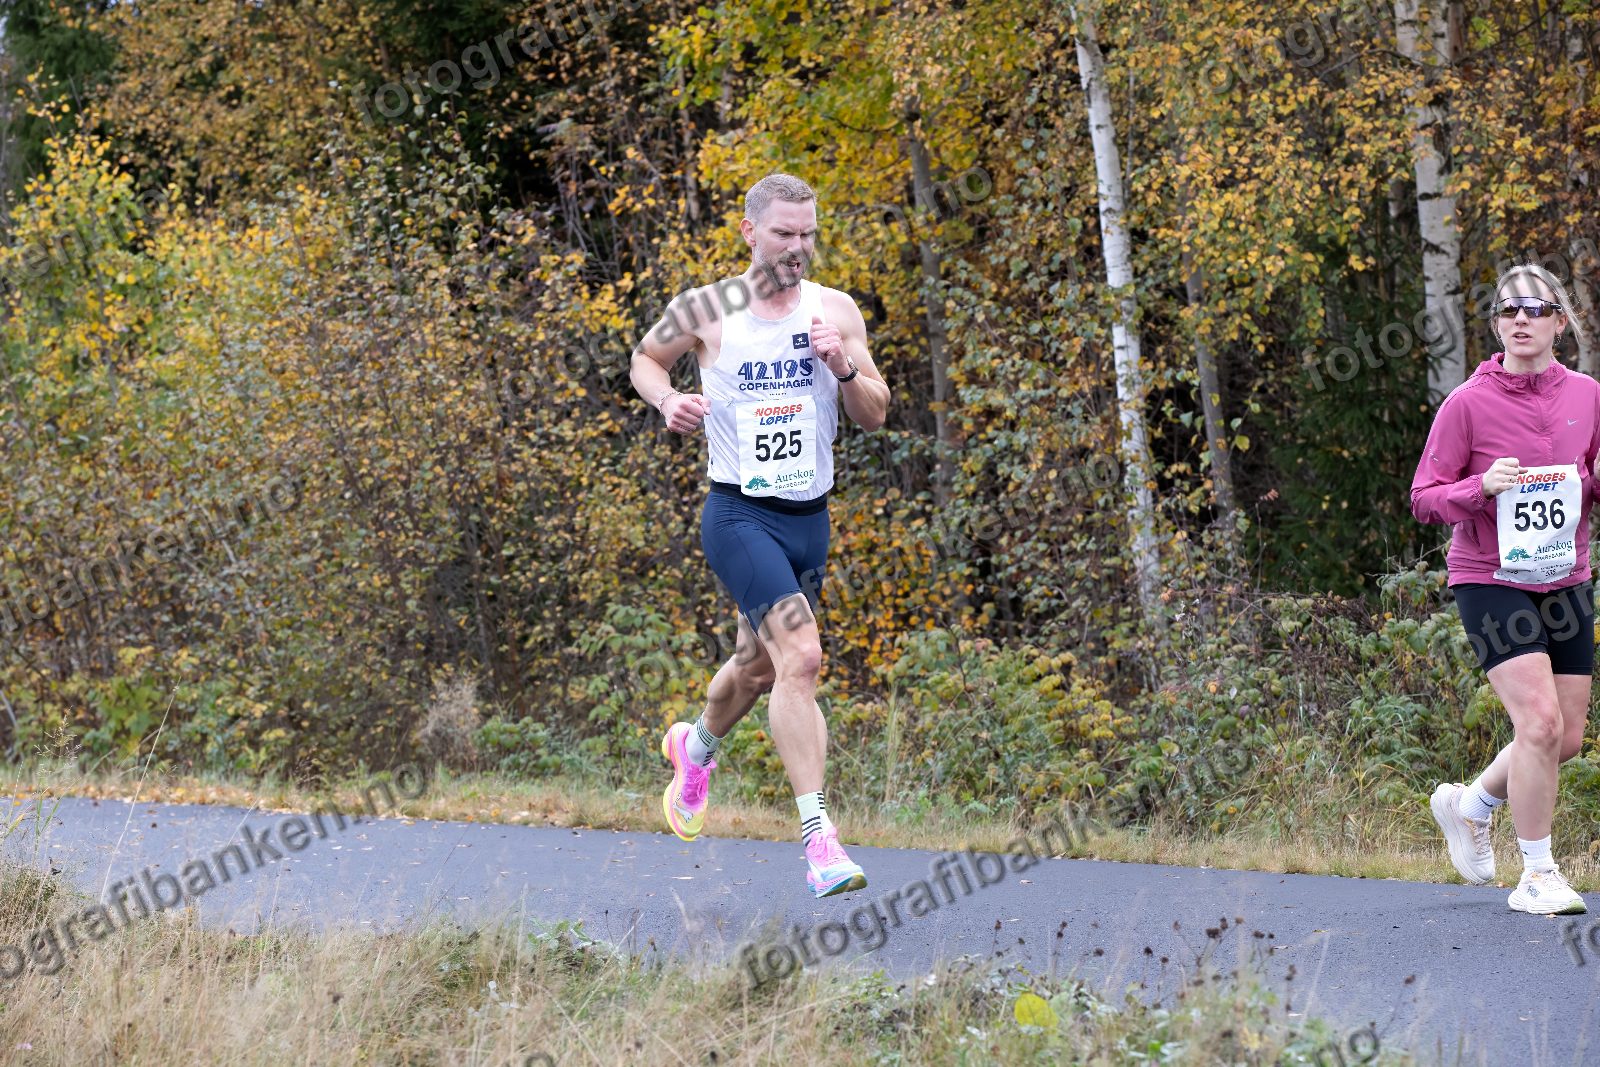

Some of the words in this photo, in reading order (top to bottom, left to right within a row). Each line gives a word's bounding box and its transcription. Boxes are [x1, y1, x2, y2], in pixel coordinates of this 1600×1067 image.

[739, 379, 812, 391] COPENHAGEN
[754, 404, 802, 417] NORGES
[760, 414, 795, 425] LØPET
[755, 430, 802, 462] 525
[774, 469, 814, 483] Aurskog
[1516, 472, 1566, 484] NORGES
[1520, 482, 1558, 493] LØPET
[1514, 499, 1565, 532] 536
[1534, 540, 1573, 555] Aurskog
